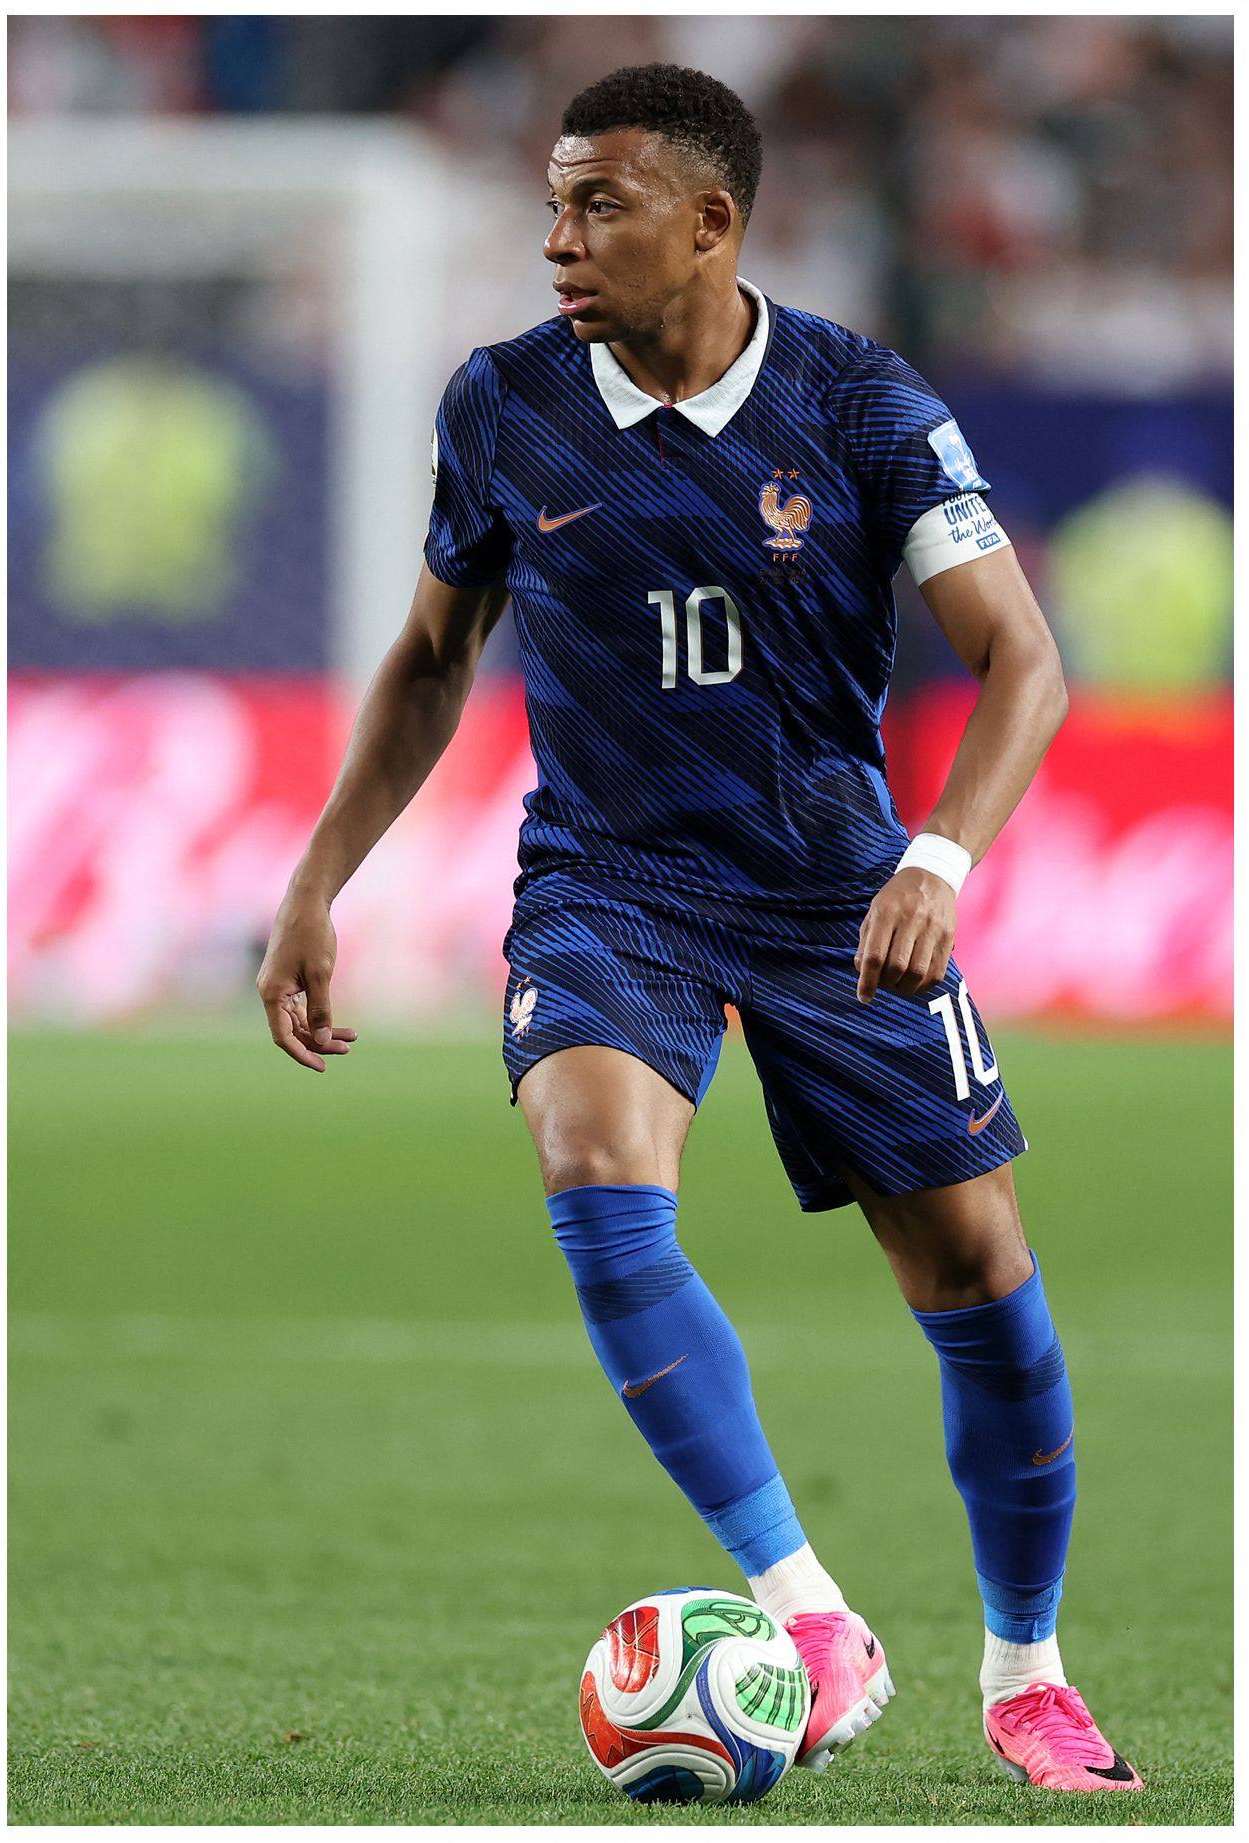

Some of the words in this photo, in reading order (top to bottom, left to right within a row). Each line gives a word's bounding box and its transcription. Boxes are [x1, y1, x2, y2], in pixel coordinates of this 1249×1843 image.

[948, 526, 973, 544] the
[978, 533, 999, 549] FIFA
[647, 585, 742, 689] 10
